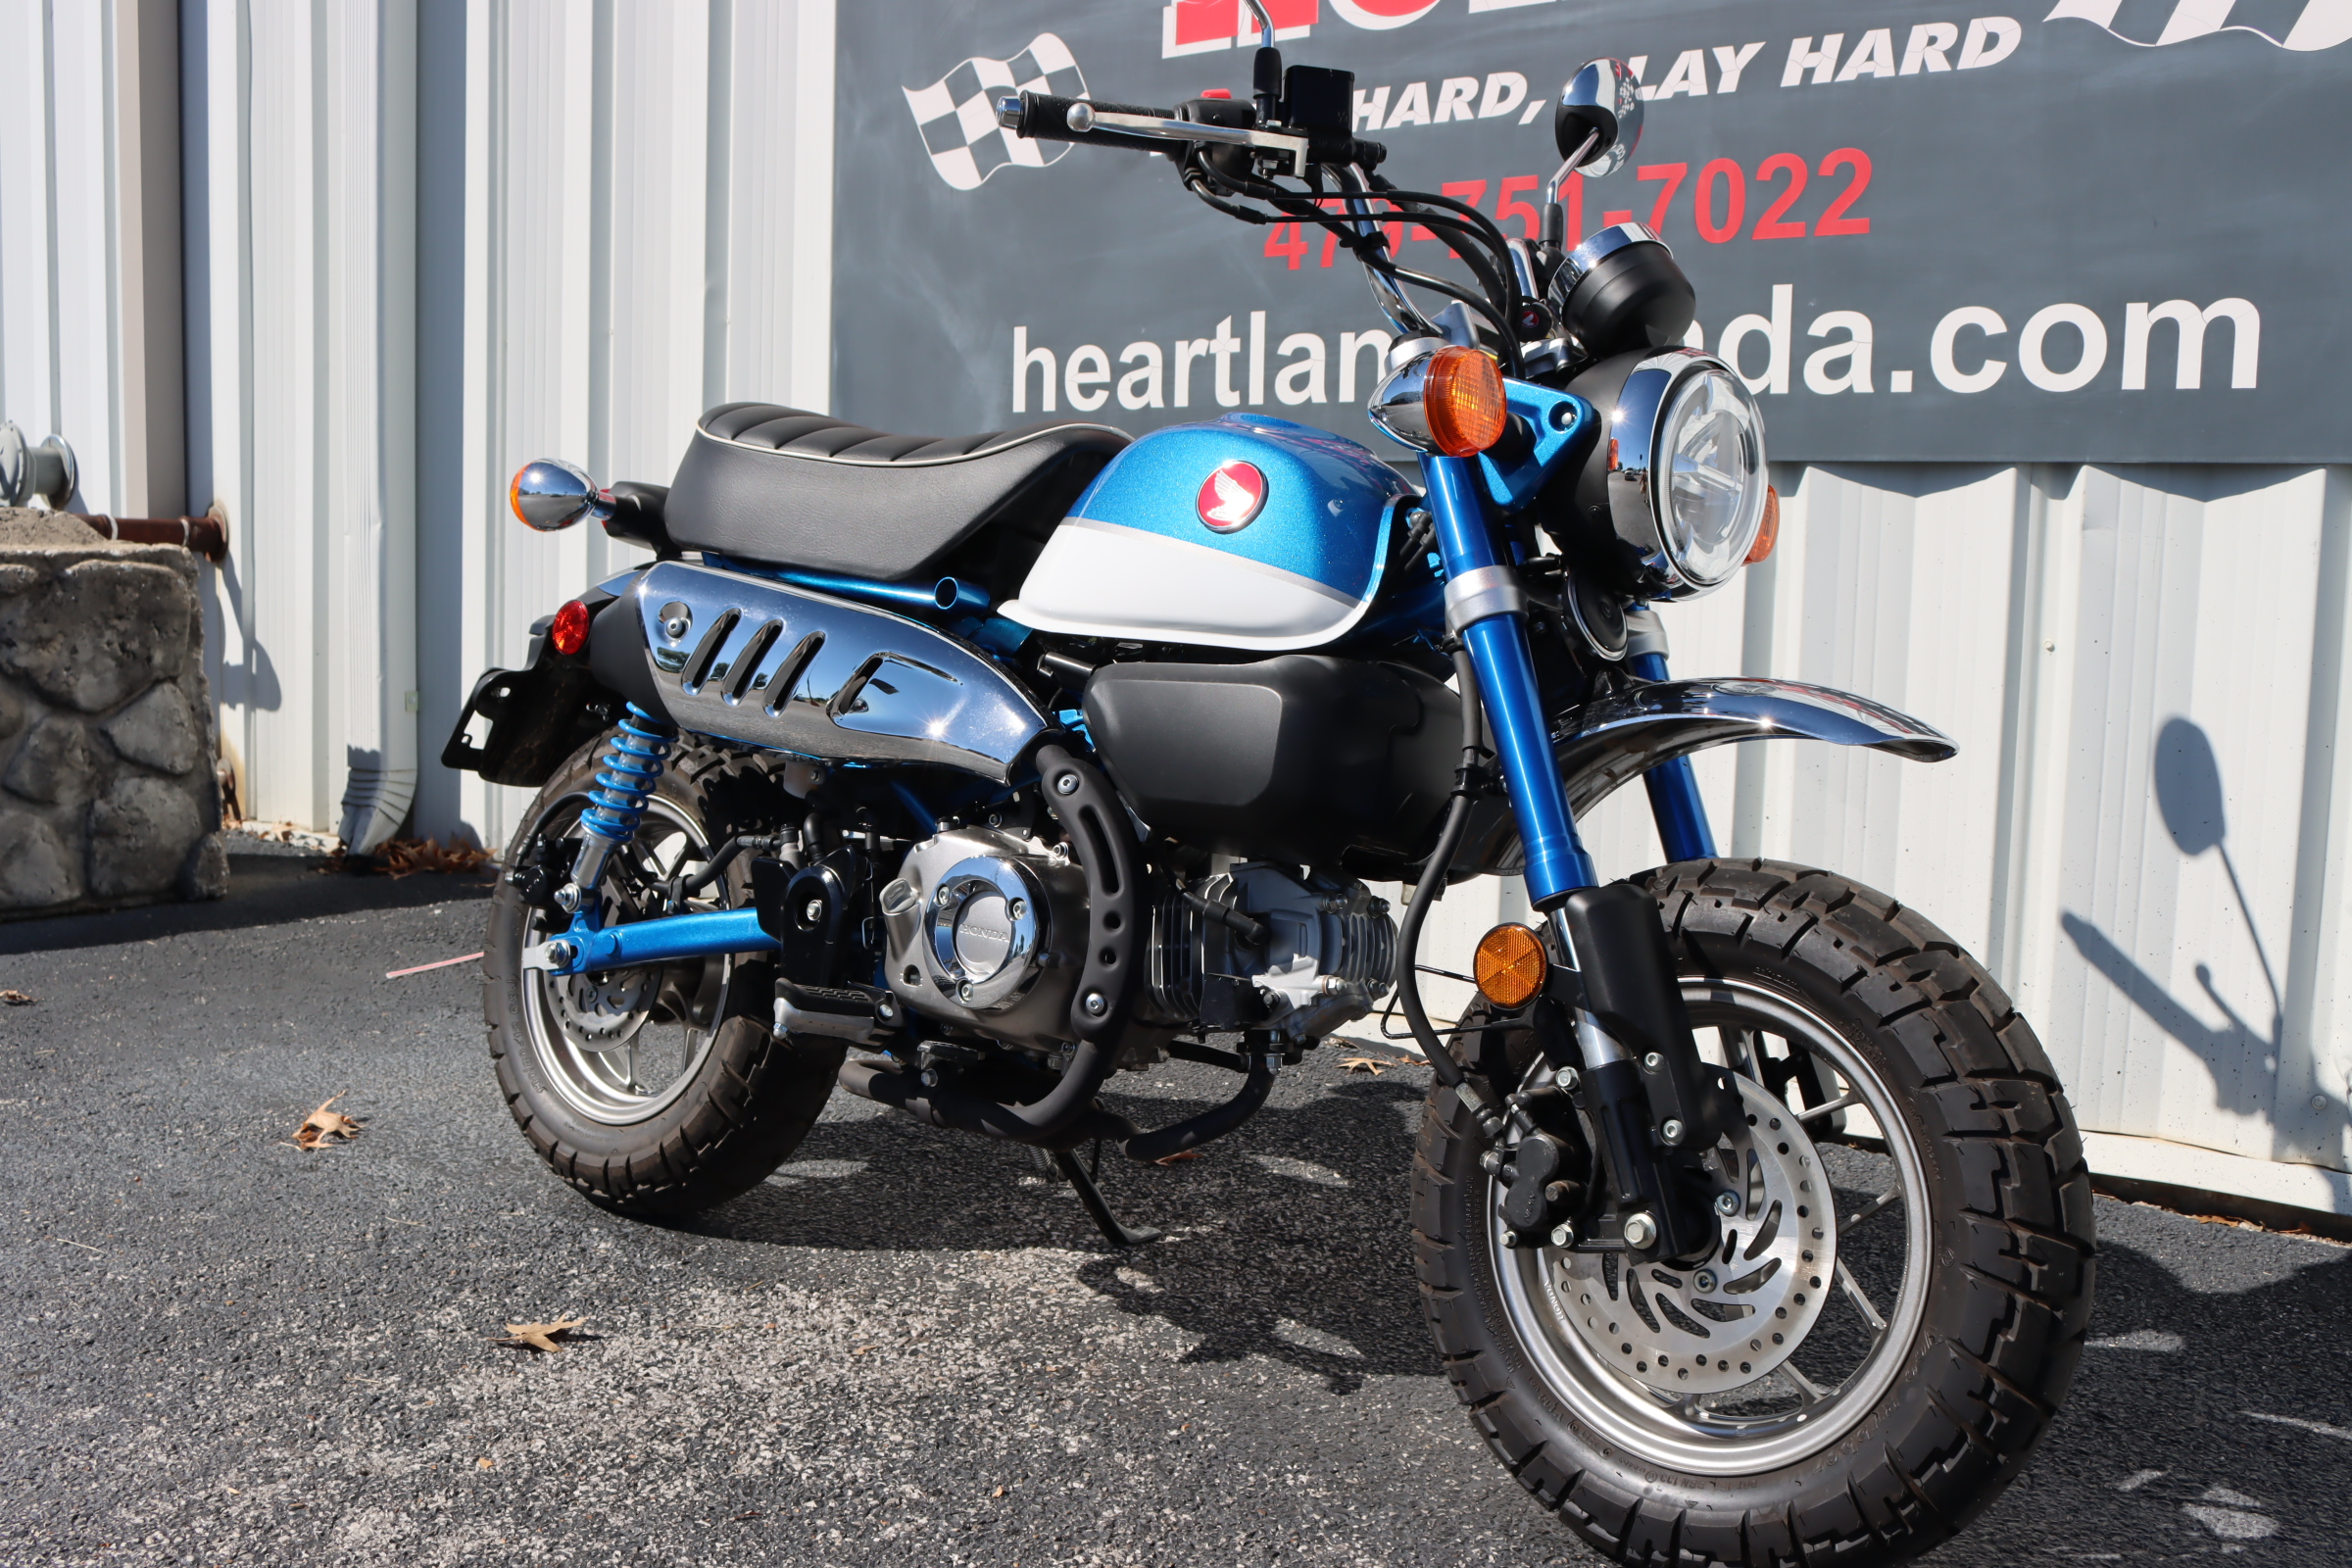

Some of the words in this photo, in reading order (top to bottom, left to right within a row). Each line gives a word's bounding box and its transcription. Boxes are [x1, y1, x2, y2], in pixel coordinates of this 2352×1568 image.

[1350, 72, 1547, 133] HARD,
[1627, 41, 1767, 102] LAY
[1780, 16, 2022, 87] HARD
[959, 923, 1010, 943] HONDA
[1544, 1279, 1564, 1321] HONDA
